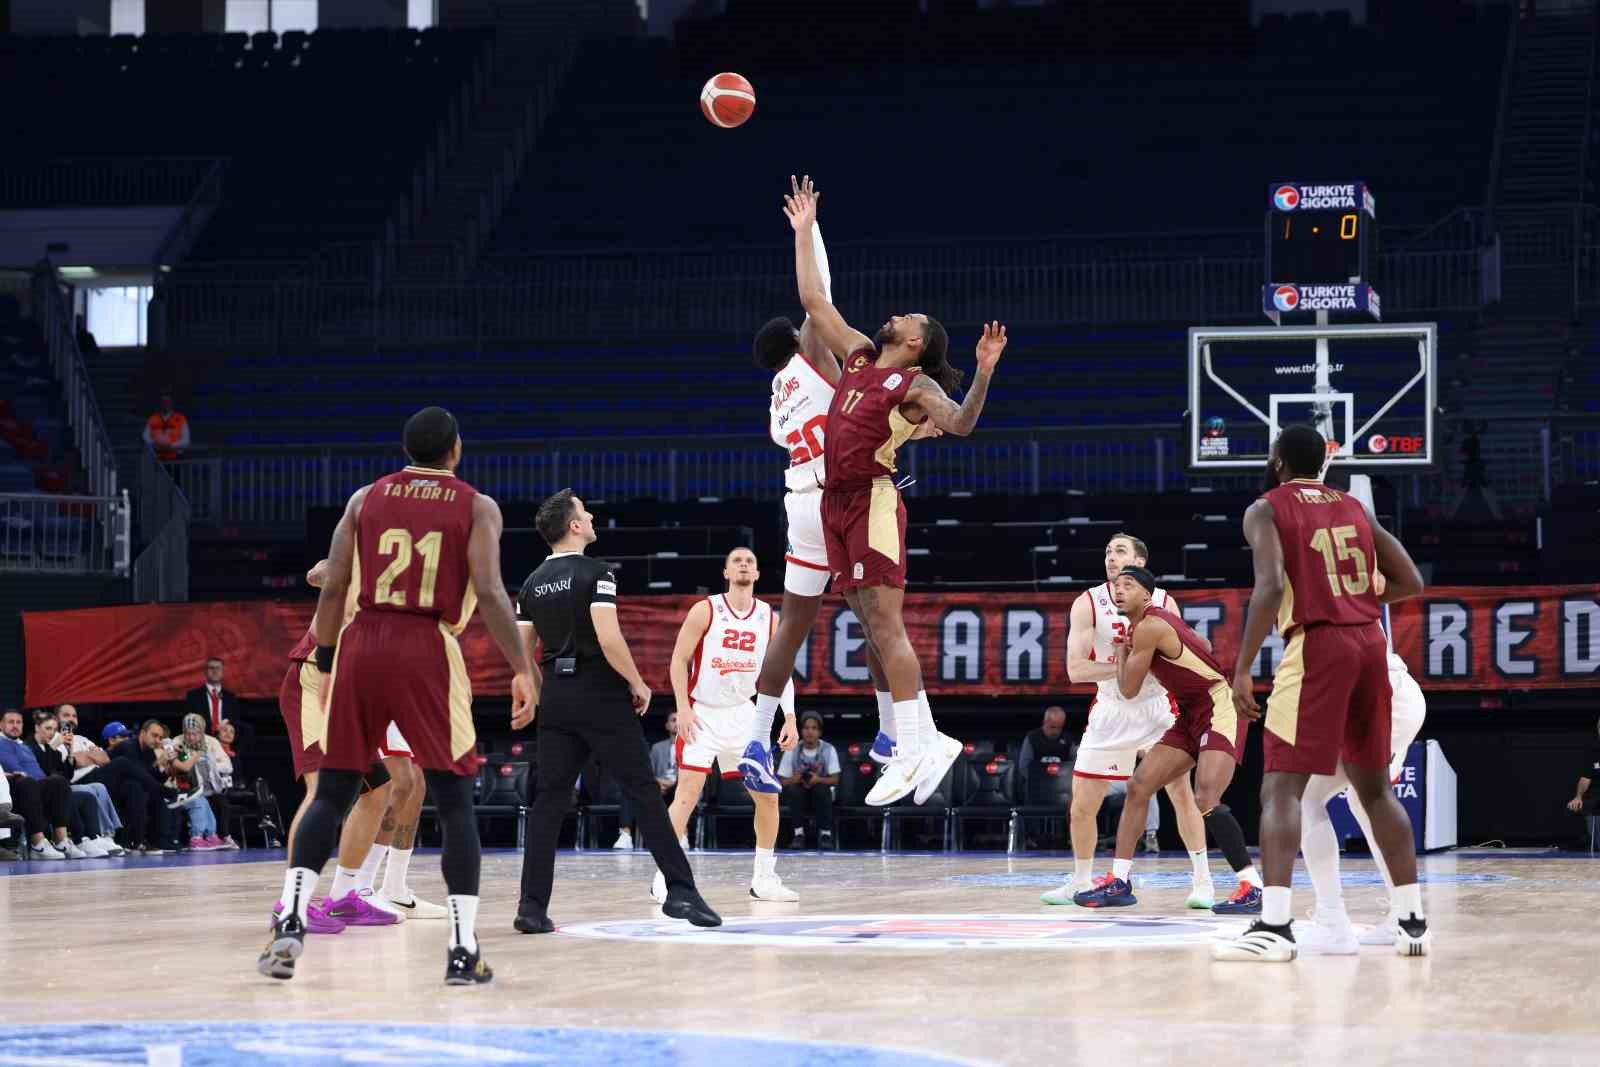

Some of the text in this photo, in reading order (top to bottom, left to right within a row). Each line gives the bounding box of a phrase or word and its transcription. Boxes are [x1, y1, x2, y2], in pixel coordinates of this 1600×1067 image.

[1389, 435, 1423, 452] TBF
[383, 483, 441, 500] TAYLOR
[375, 528, 443, 607] 21
[1309, 524, 1369, 597] 15
[722, 628, 756, 652] 22
